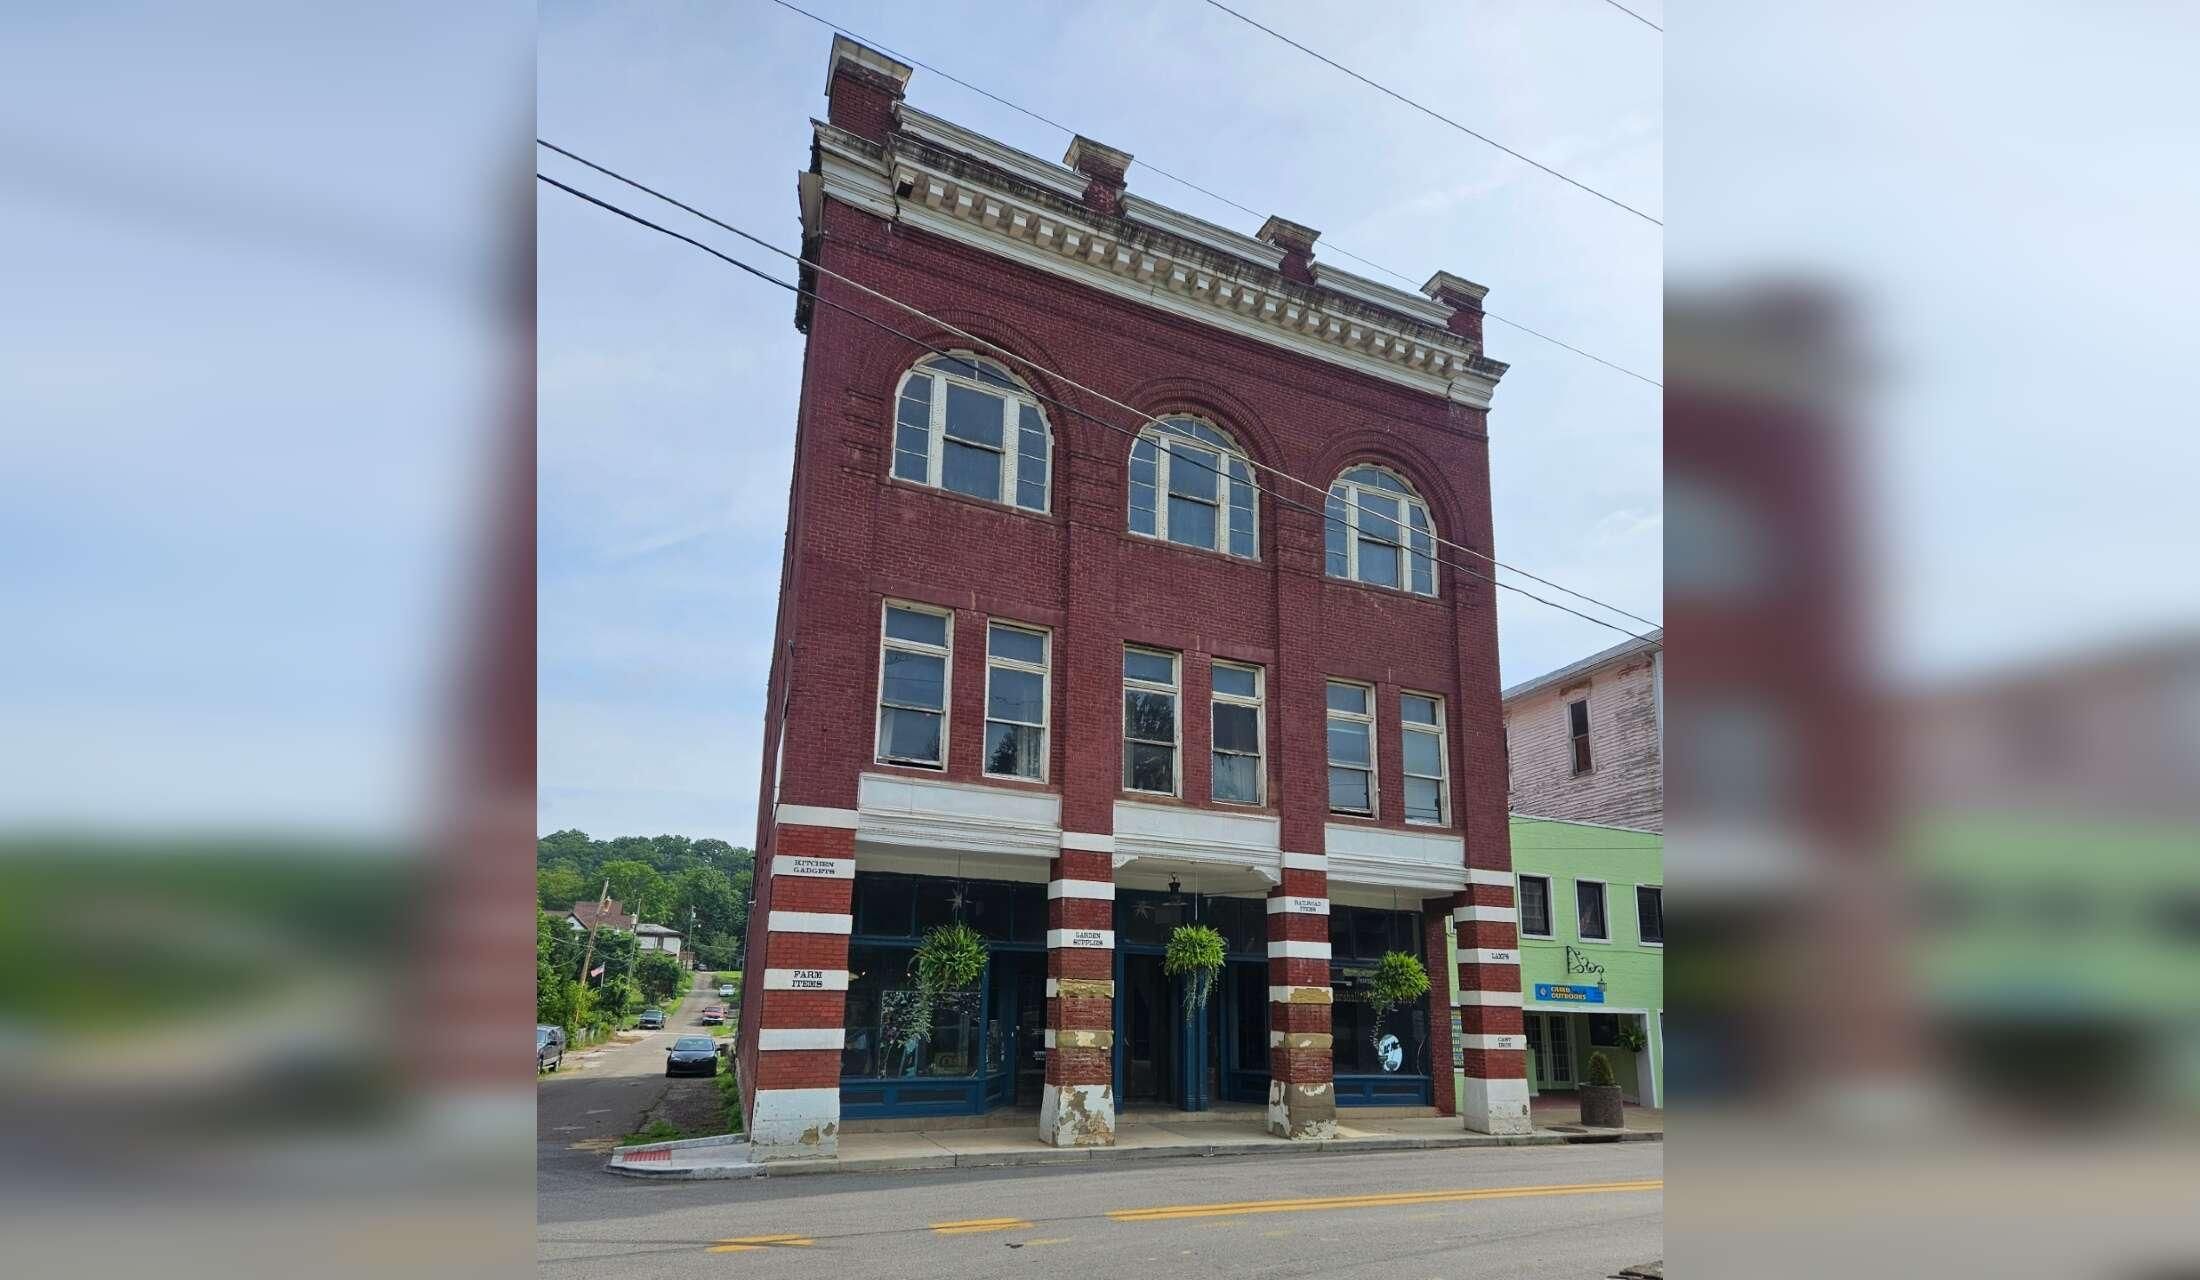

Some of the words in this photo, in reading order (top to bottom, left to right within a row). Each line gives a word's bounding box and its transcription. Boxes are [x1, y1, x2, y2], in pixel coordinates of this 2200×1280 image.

[794, 859, 834, 867] KITCHEN
[793, 866, 835, 874] GADGETS
[793, 970, 823, 979] FARM
[792, 979, 823, 988] ITEMS
[1551, 992, 1586, 1000] OUTDOORS
